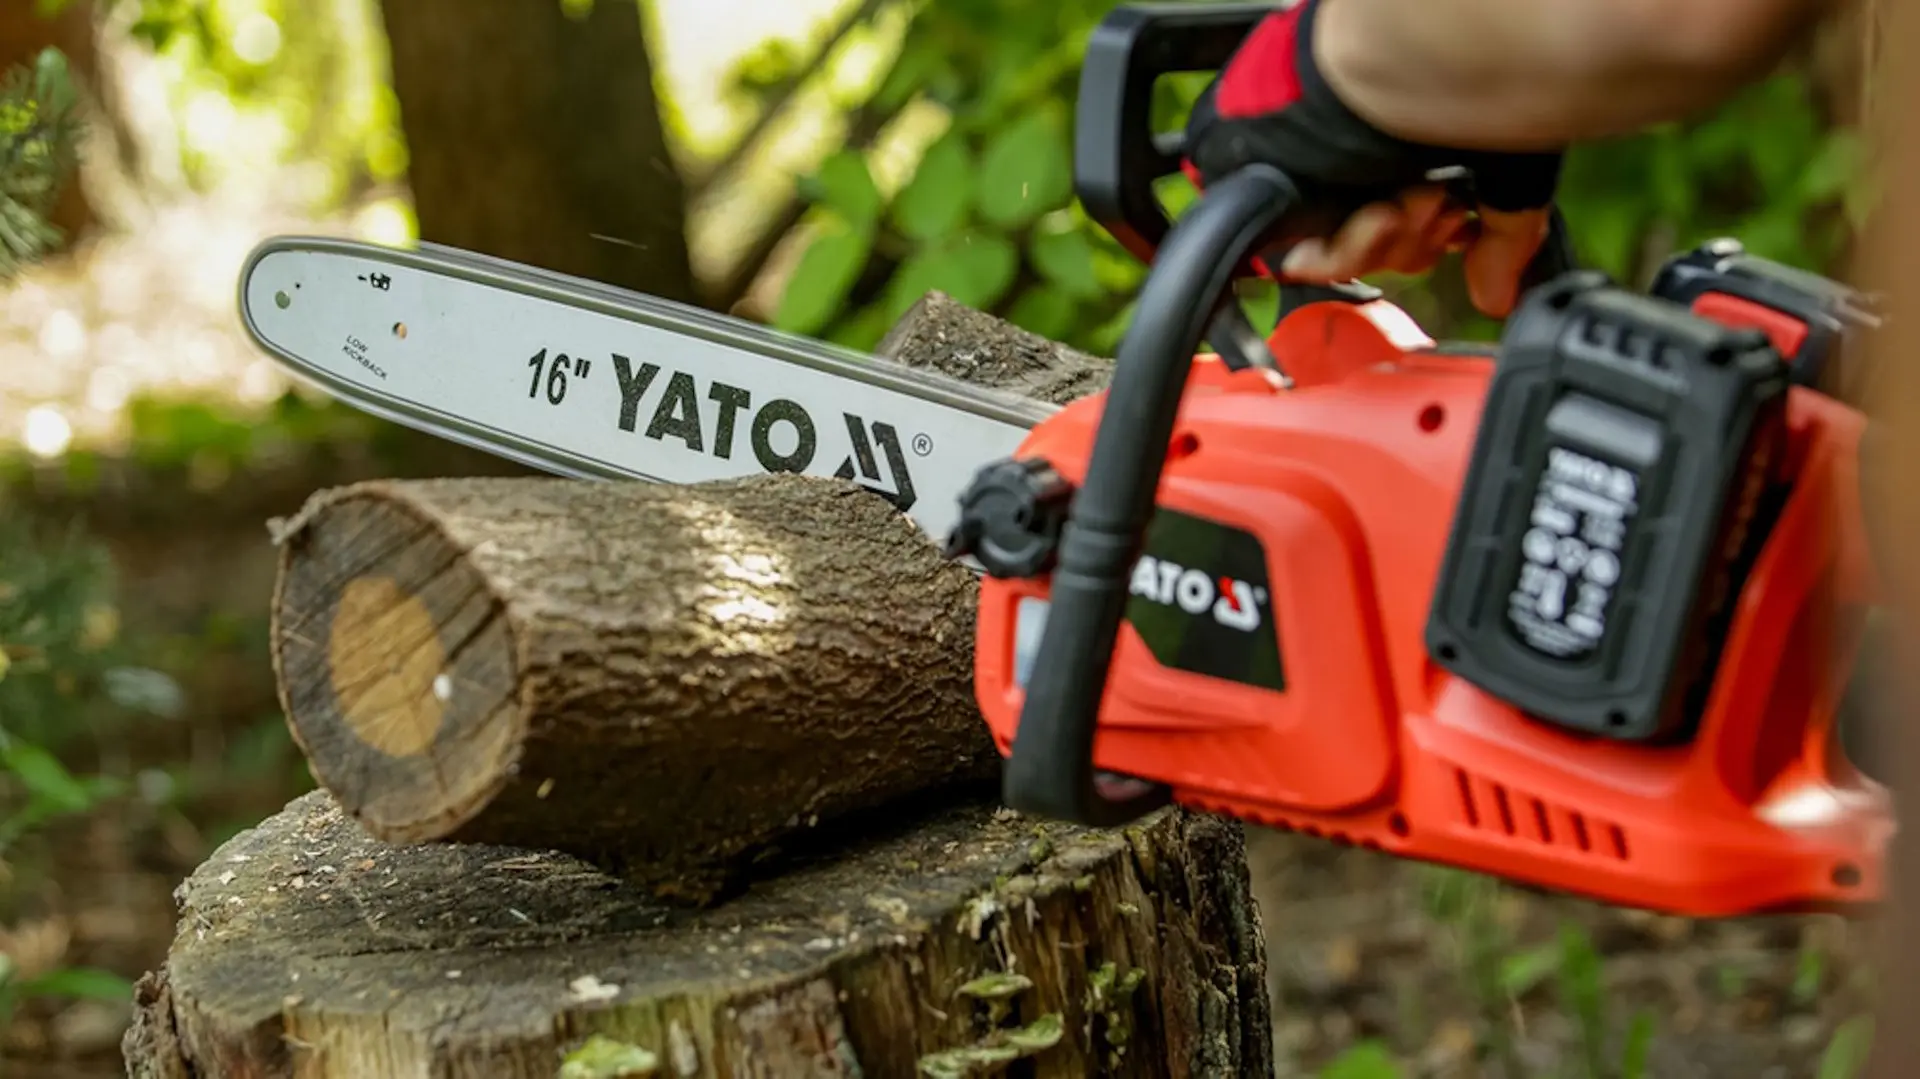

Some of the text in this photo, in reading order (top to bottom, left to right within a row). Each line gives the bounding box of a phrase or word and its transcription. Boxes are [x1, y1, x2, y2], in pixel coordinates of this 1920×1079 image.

[342, 345, 388, 380] KICKBACK
[346, 334, 369, 353] LOW
[527, 347, 592, 406] 16"
[611, 353, 817, 473] YATO
[1128, 554, 1214, 615] ATO
